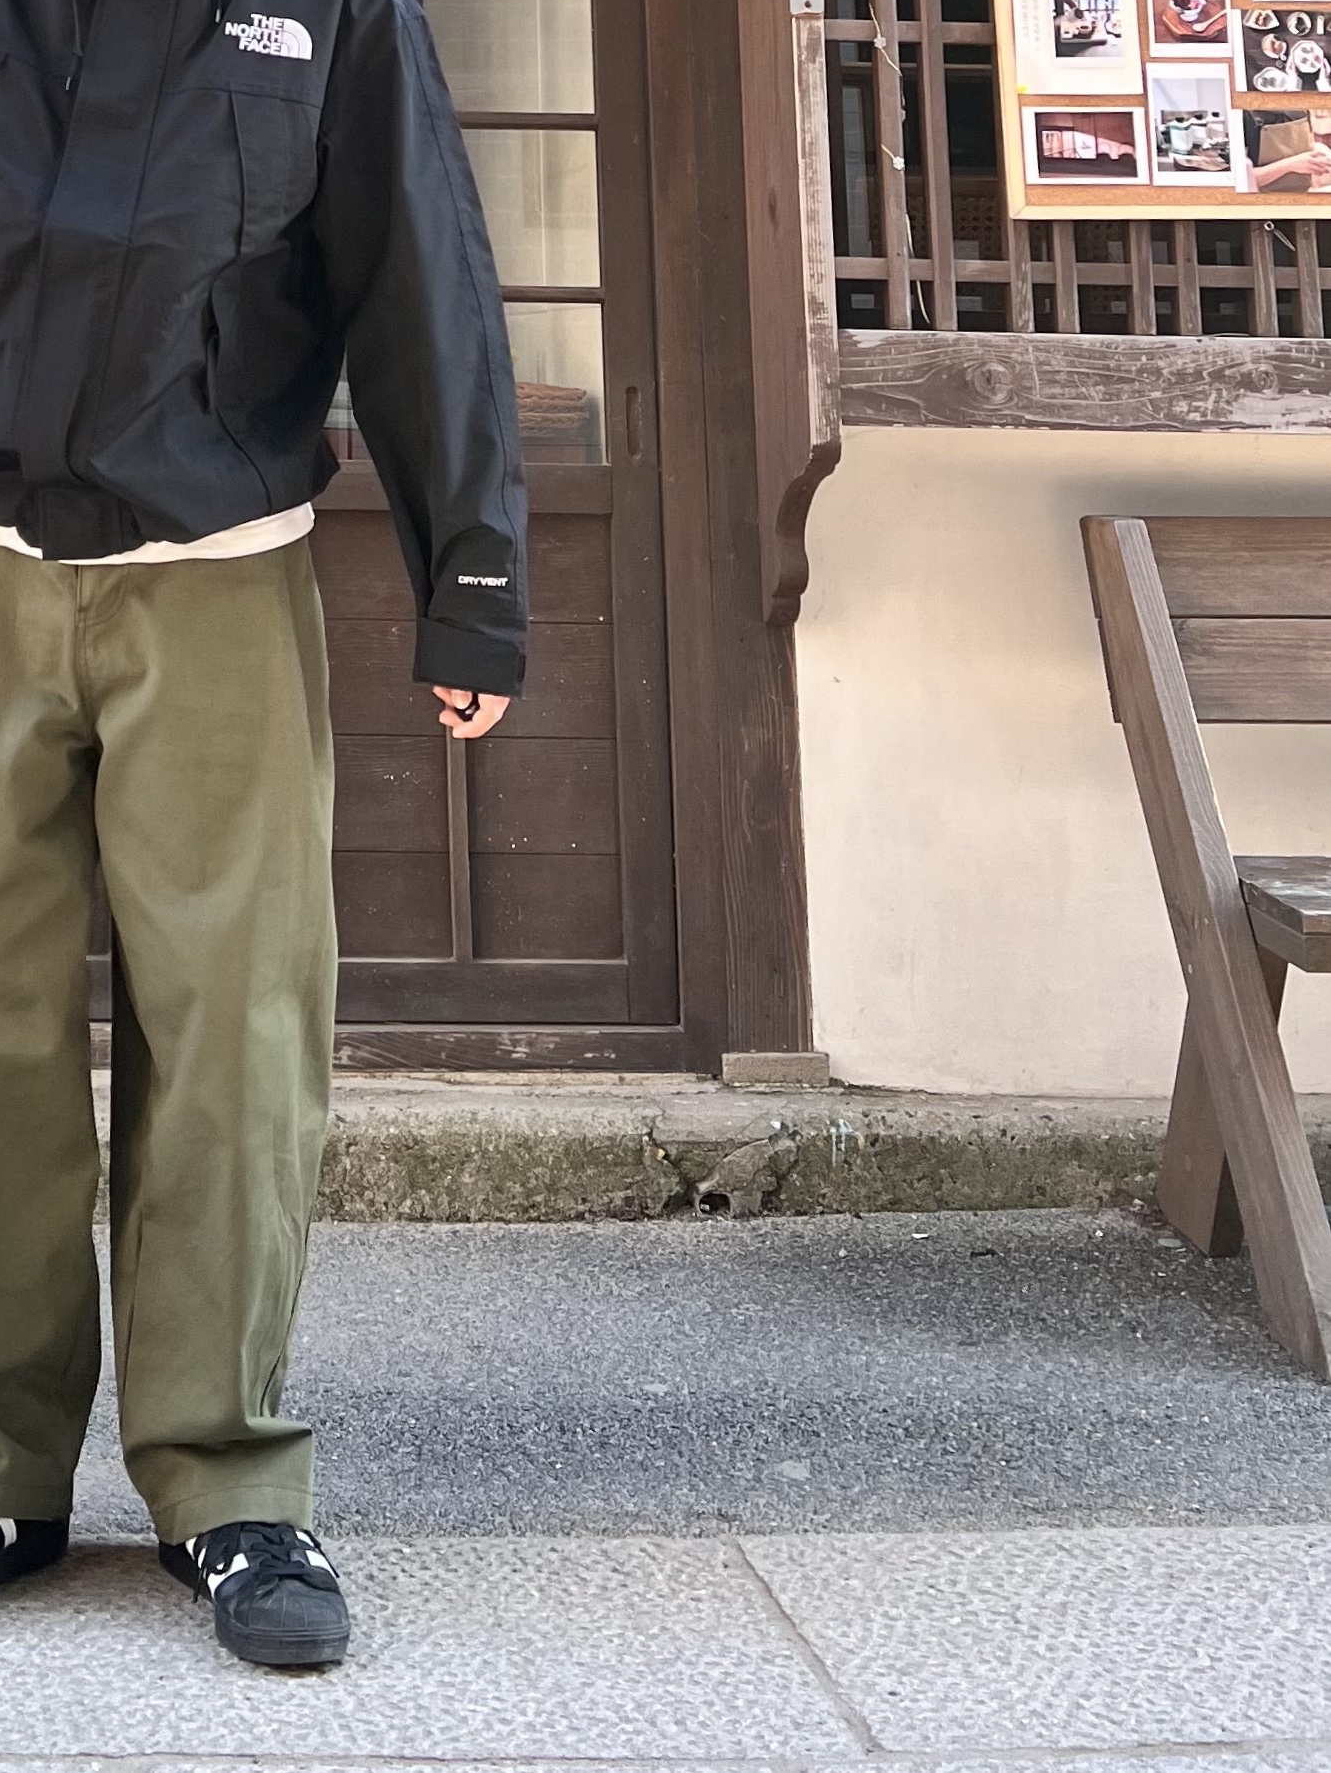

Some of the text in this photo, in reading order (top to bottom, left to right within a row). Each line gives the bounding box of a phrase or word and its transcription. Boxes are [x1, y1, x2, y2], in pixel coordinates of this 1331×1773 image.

[250, 13, 284, 30] THE
[224, 21, 282, 43] NORTH
[238, 37, 282, 56] FACE
[457, 575, 509, 587] DRYVENT
